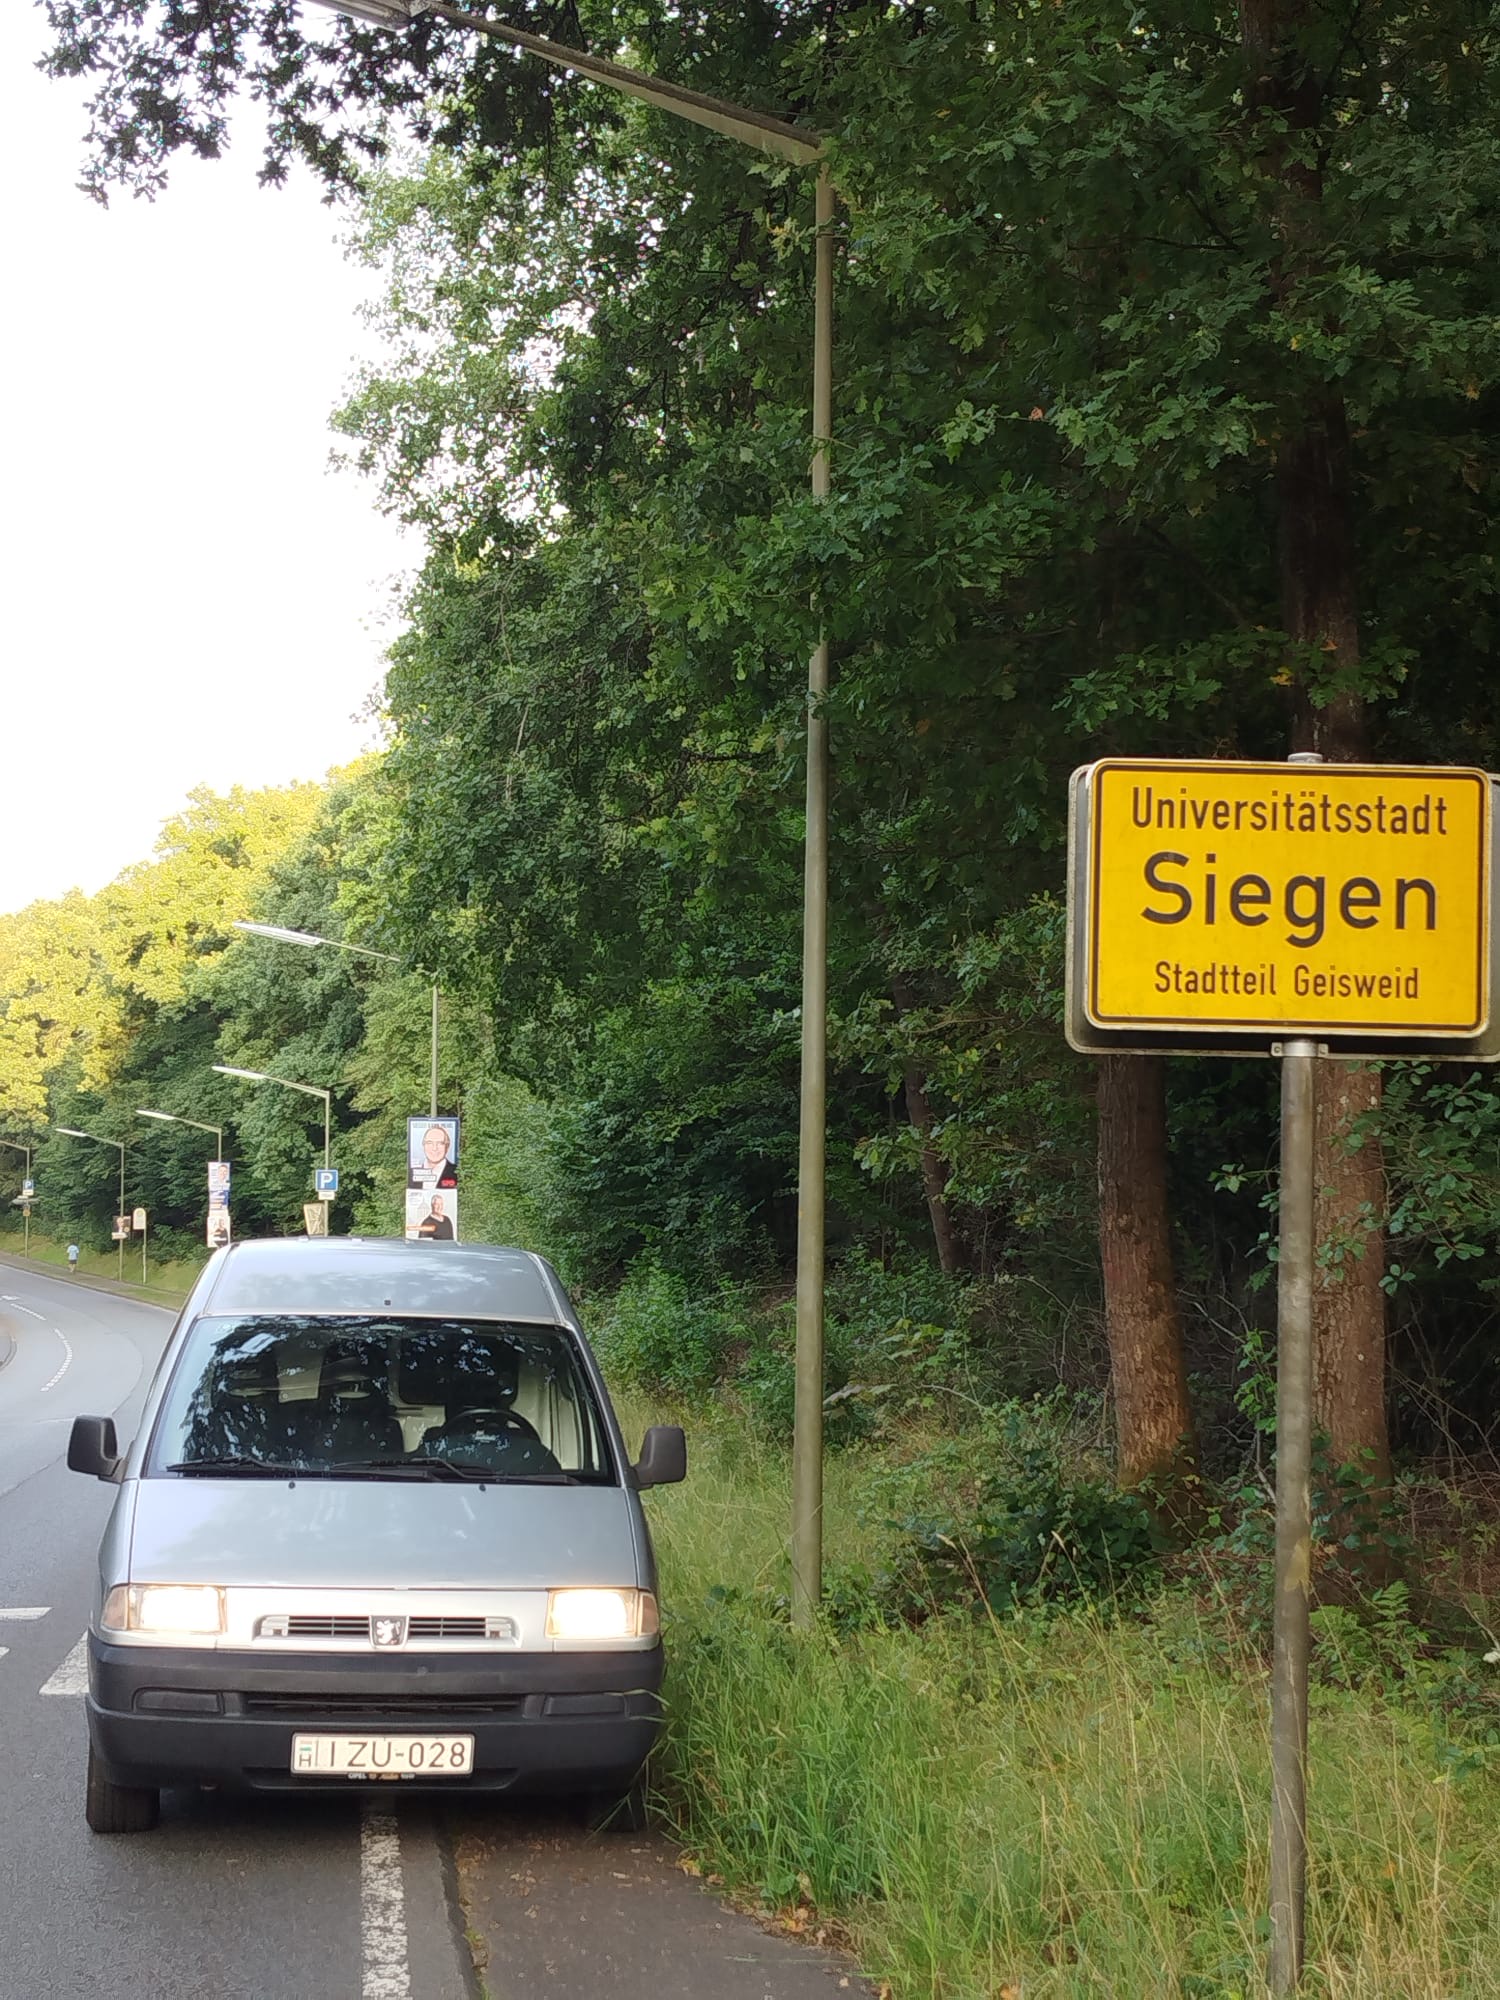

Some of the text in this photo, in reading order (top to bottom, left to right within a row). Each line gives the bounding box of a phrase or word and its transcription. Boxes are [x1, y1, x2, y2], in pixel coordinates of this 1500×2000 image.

[1132, 786, 1447, 834] Universitätsstadt
[1140, 851, 1436, 948] Siegen
[1154, 961, 1419, 999] Stadtteil Geisweid
[320, 1173, 333, 1189] P
[299, 1741, 465, 1768] H IZU-028
